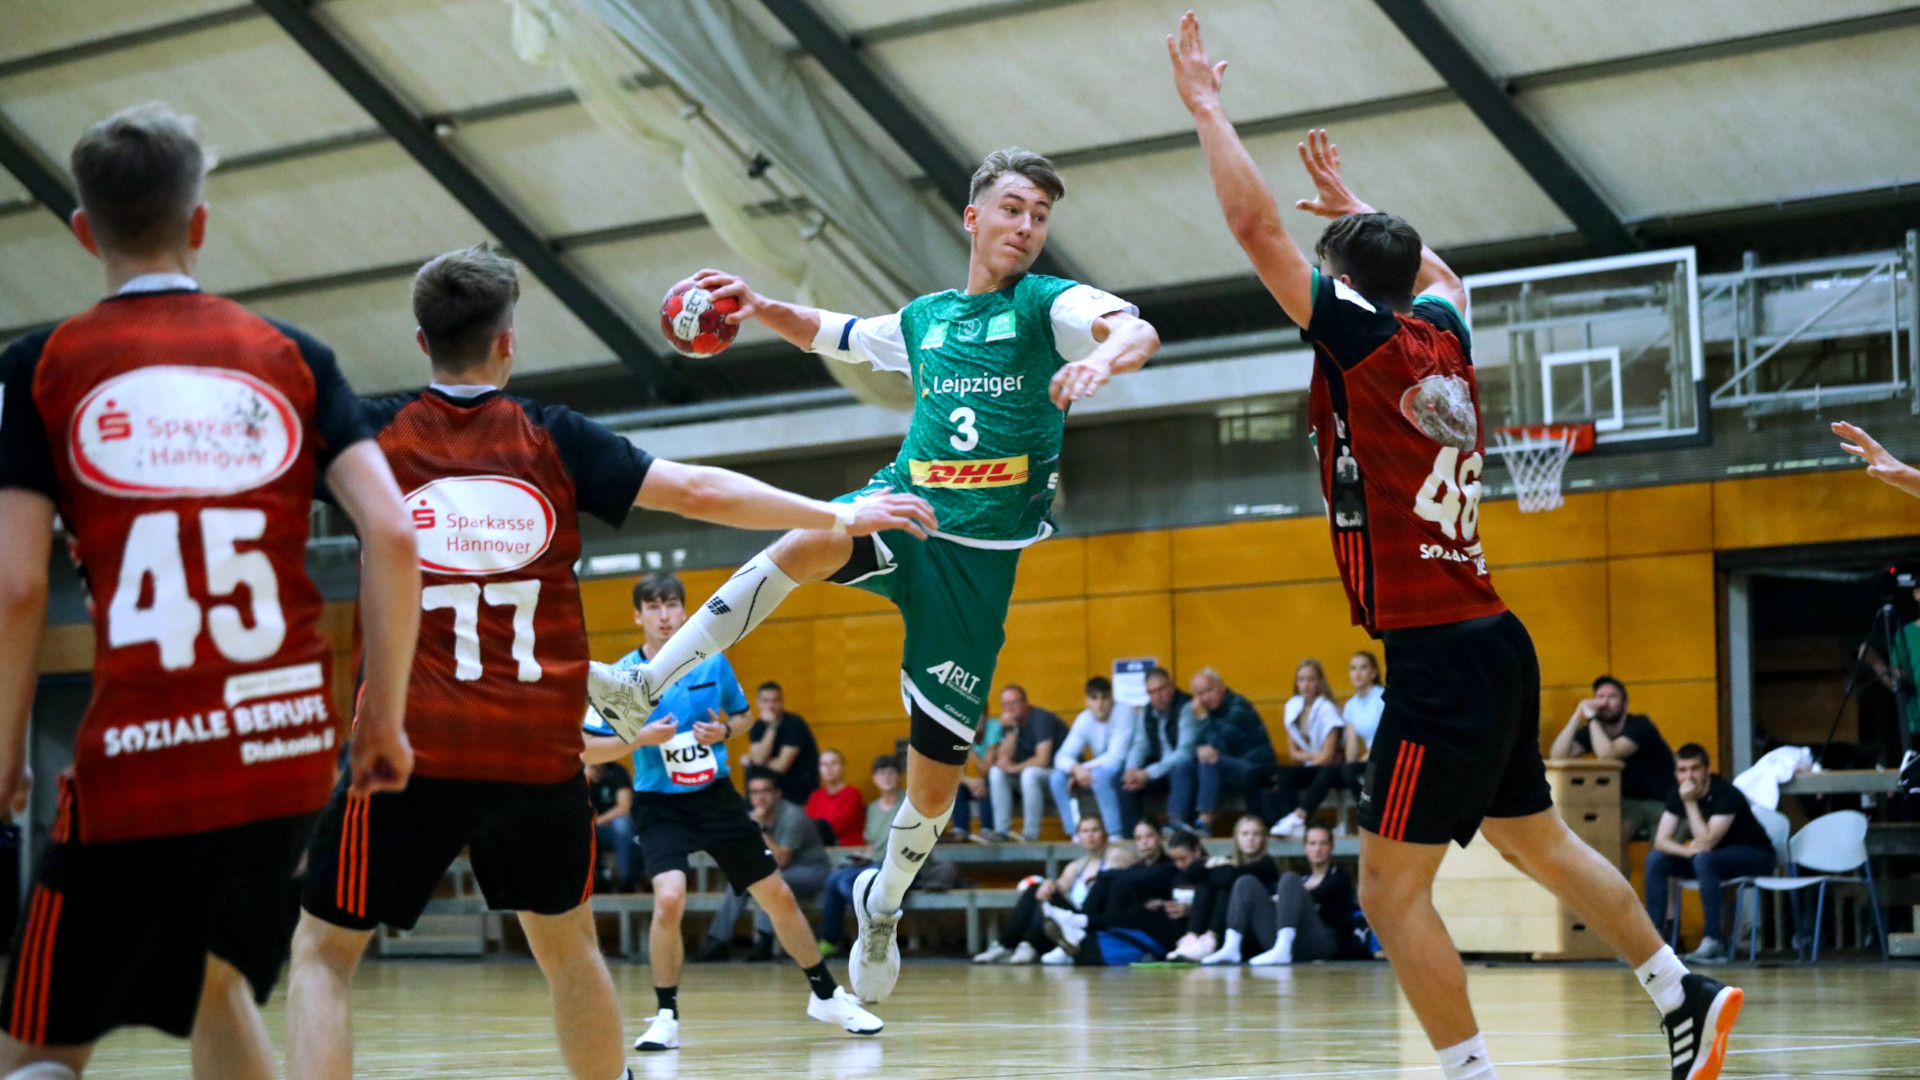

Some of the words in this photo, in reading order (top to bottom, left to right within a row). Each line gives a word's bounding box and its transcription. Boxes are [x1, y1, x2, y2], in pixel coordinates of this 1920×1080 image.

[678, 290, 706, 337] SELECT
[933, 371, 1025, 398] Leipziger
[949, 406, 979, 452] 3
[924, 462, 1013, 484] DHL
[1413, 446, 1484, 541] 46
[446, 512, 535, 532] Sparkasse
[446, 535, 532, 554] Hannover
[108, 507, 287, 672] 45
[421, 578, 543, 682] 77
[926, 660, 981, 694] ARLT
[104, 709, 231, 757] SOZIALE
[223, 694, 329, 735] BERUFE
